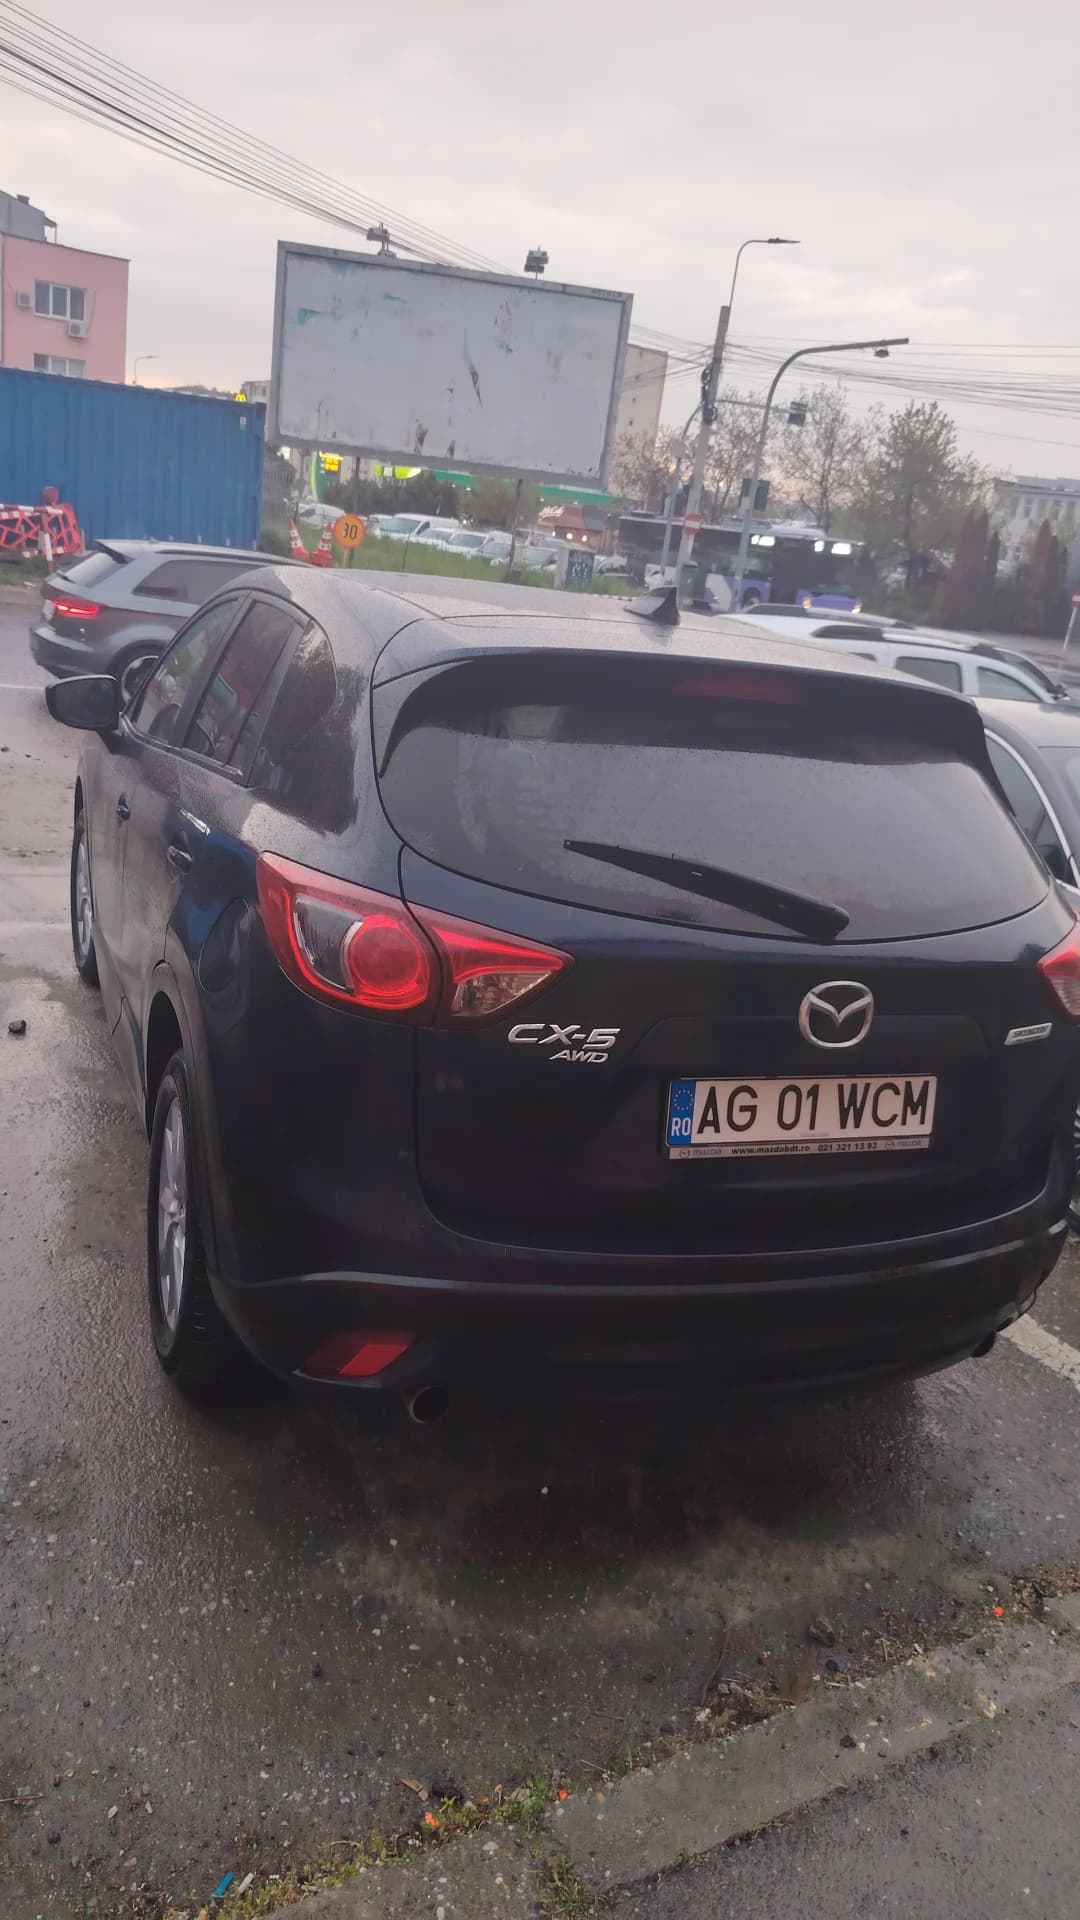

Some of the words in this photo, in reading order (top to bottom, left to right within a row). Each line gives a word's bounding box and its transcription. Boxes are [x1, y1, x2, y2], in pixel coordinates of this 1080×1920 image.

[343, 522, 358, 540] 30
[507, 1023, 621, 1050] CX-5
[548, 1049, 609, 1063] AWD
[697, 1084, 759, 1135] AG
[777, 1083, 820, 1132] 01
[837, 1080, 930, 1129] WCM
[670, 1117, 691, 1137] RO
[817, 1144, 833, 1152] 021
[835, 1143, 852, 1151] 321
